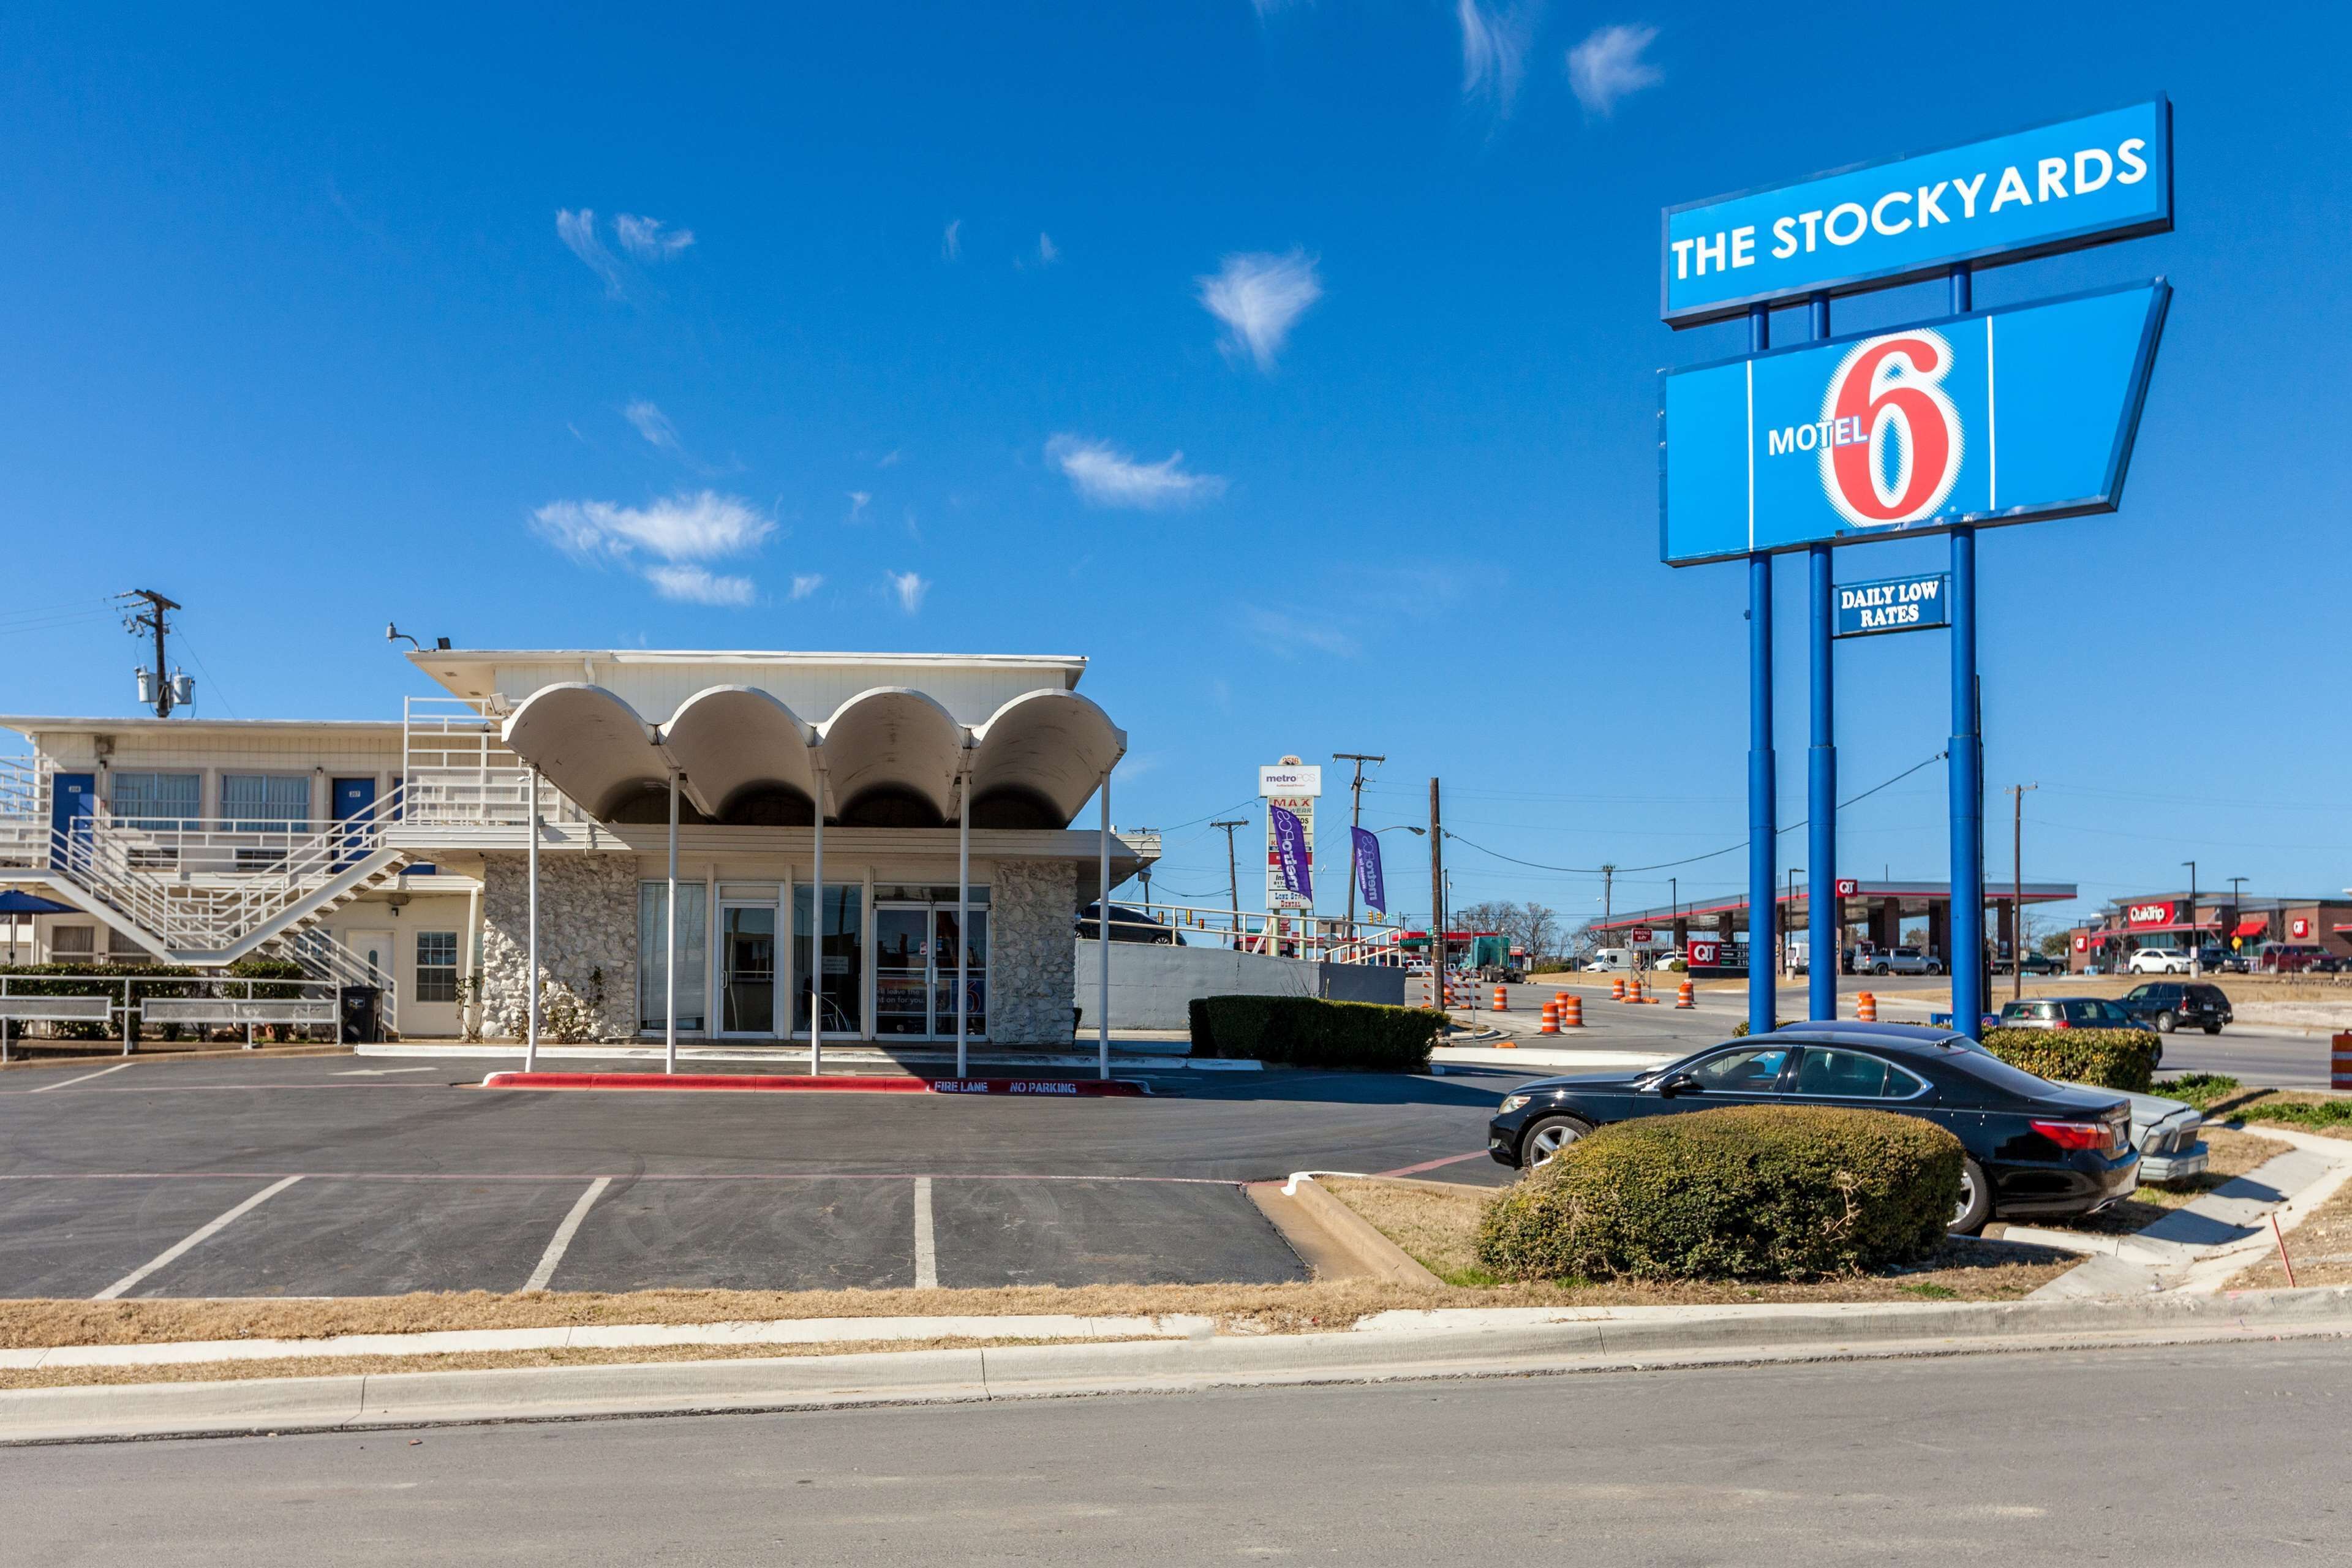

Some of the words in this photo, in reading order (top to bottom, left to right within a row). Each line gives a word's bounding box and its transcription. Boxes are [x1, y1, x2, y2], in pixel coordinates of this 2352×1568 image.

[1671, 225, 1755, 280] THE
[1771, 138, 2148, 260] STOCKYARDS
[1768, 415, 1868, 456] MOTEL
[1831, 338, 1950, 521] 6
[1841, 586, 1896, 609] DAILY
[1898, 580, 1939, 603] LOW
[1860, 603, 1920, 628] RATES
[1266, 773, 1316, 782] metroPCS
[1273, 798, 1310, 807] MAX
[1839, 881, 1855, 894] QT
[2130, 906, 2165, 922] QuikTrip
[1694, 944, 1716, 962] QT
[934, 1081, 959, 1091] FIRE
[960, 1081, 988, 1092] LANE
[1010, 1082, 1026, 1092] NO
[1028, 1082, 1077, 1093] PARKING
